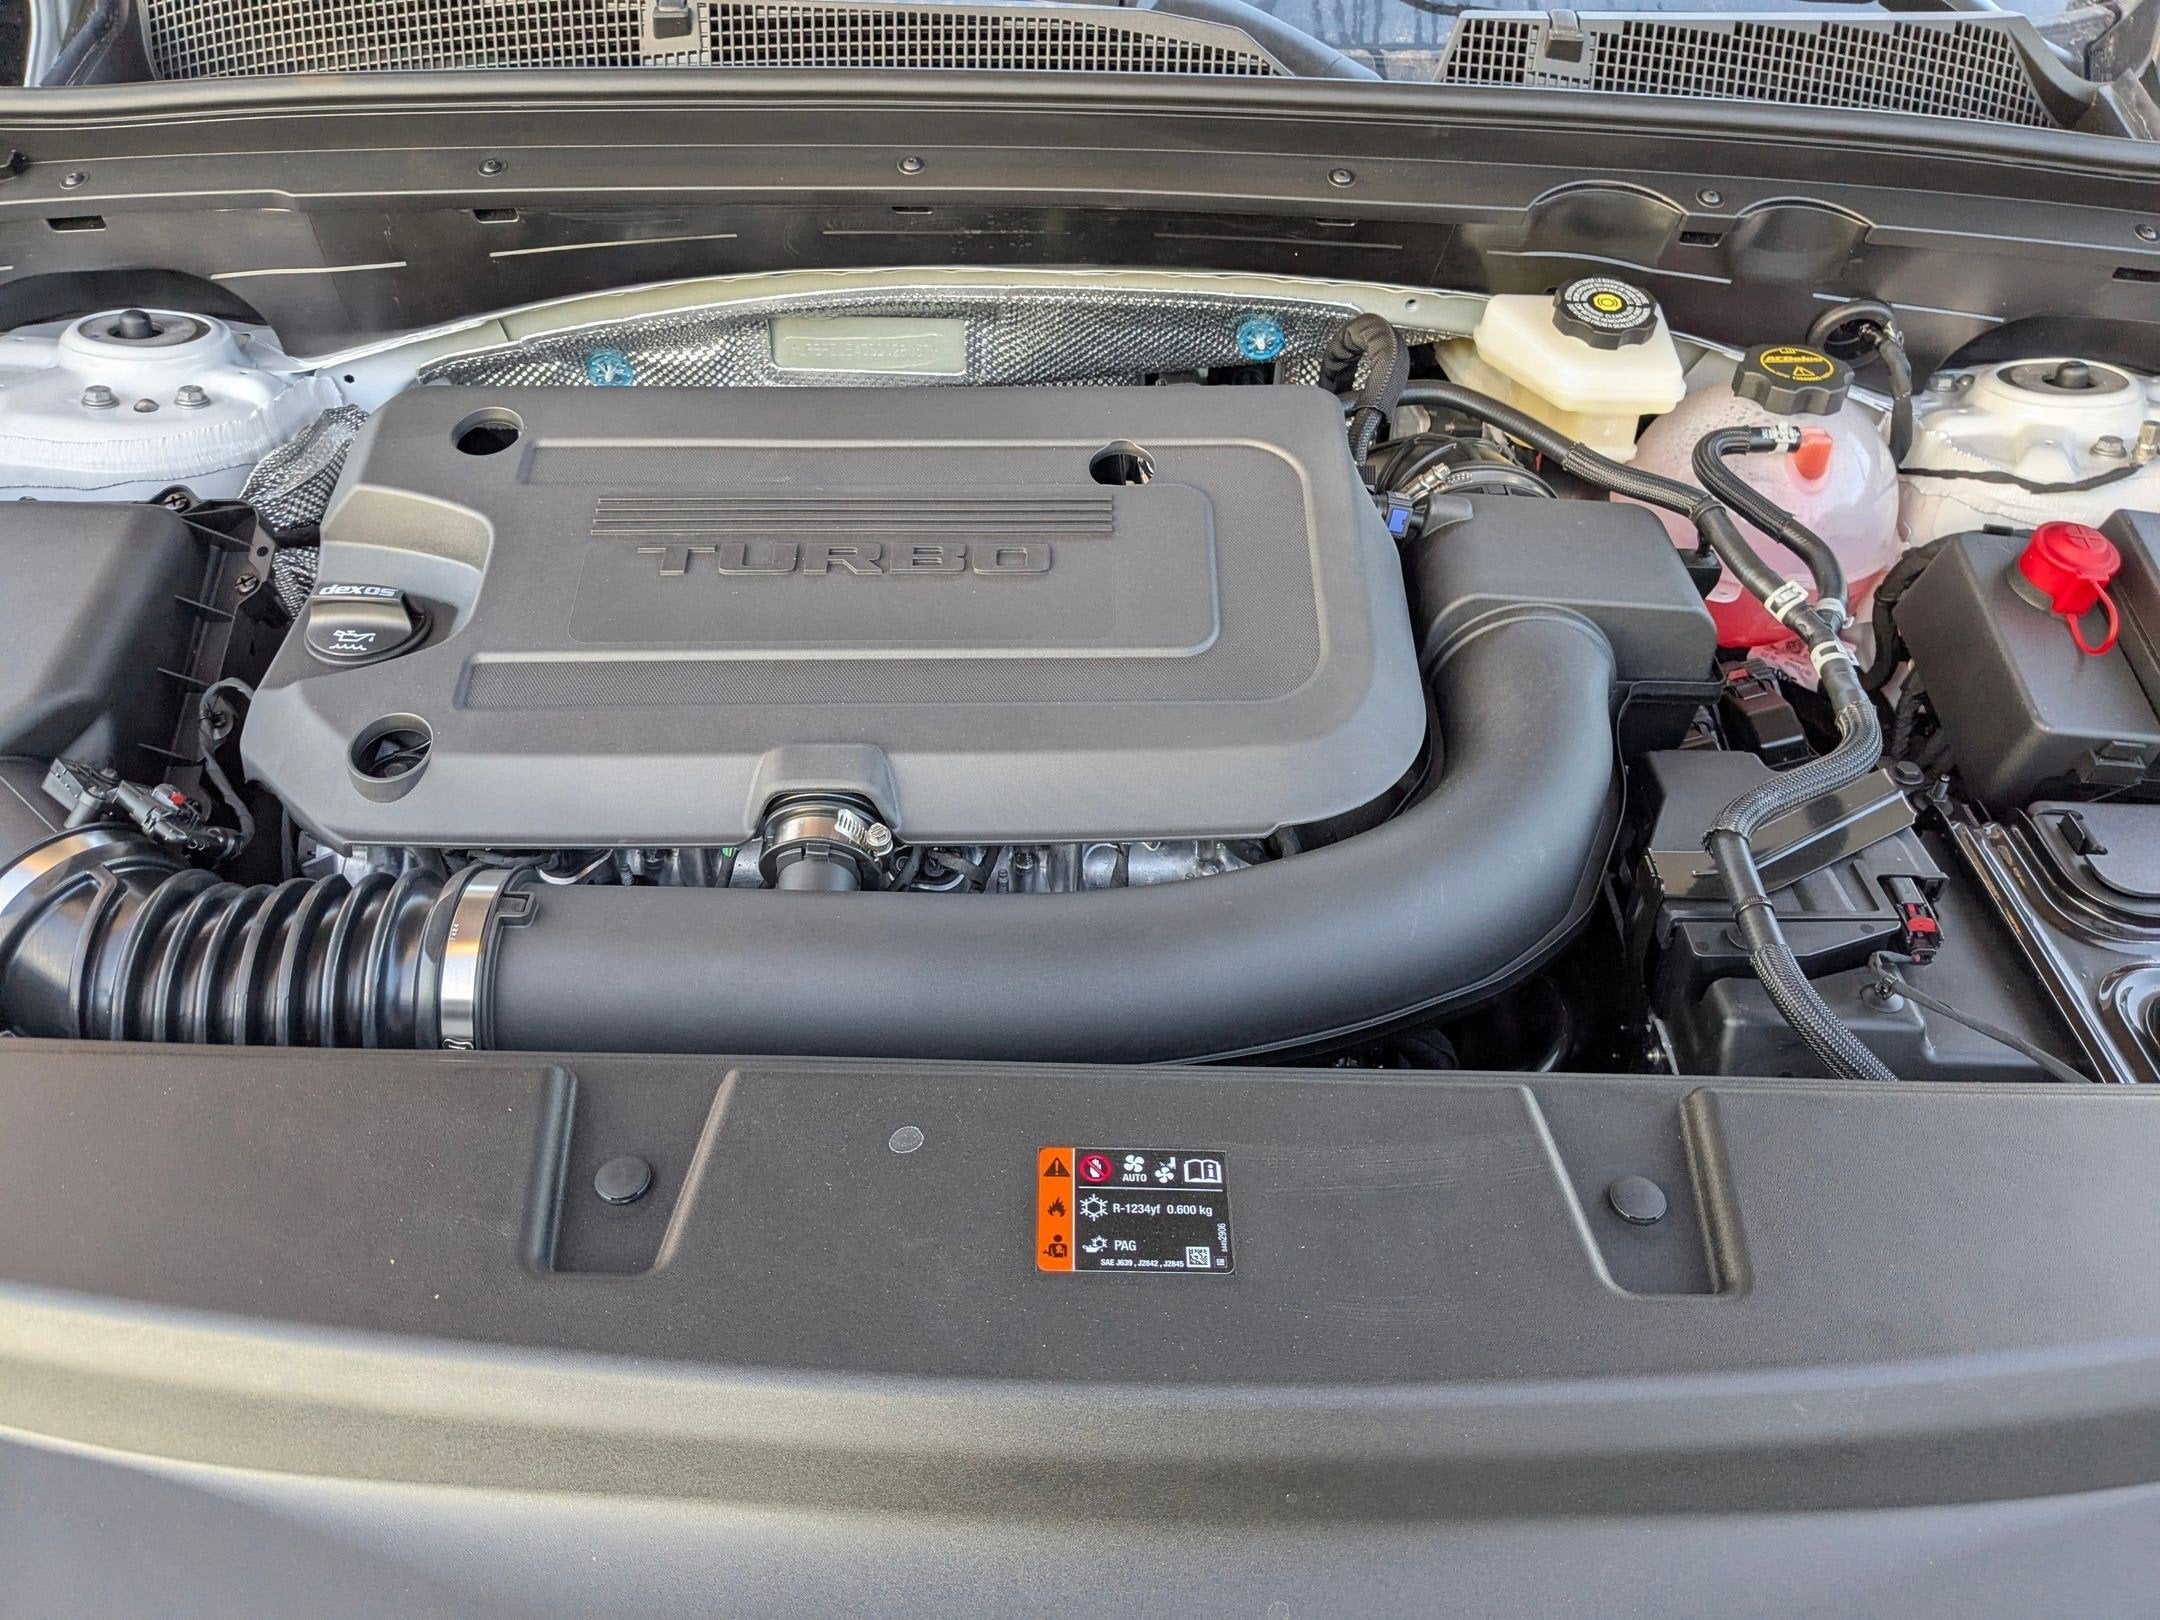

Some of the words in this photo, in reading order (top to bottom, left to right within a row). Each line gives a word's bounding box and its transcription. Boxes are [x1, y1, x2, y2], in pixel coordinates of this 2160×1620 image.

[637, 542, 1051, 576] TURBO
[319, 584, 399, 597] dexos
[1122, 1173, 1148, 1183] AUTO
[1112, 1203, 1161, 1216] R-1234yf
[1166, 1204, 1197, 1215] 0.600
[1199, 1204, 1213, 1217] kg
[1114, 1240, 1137, 1251] PAG
[1100, 1258, 1115, 1266] SAE
